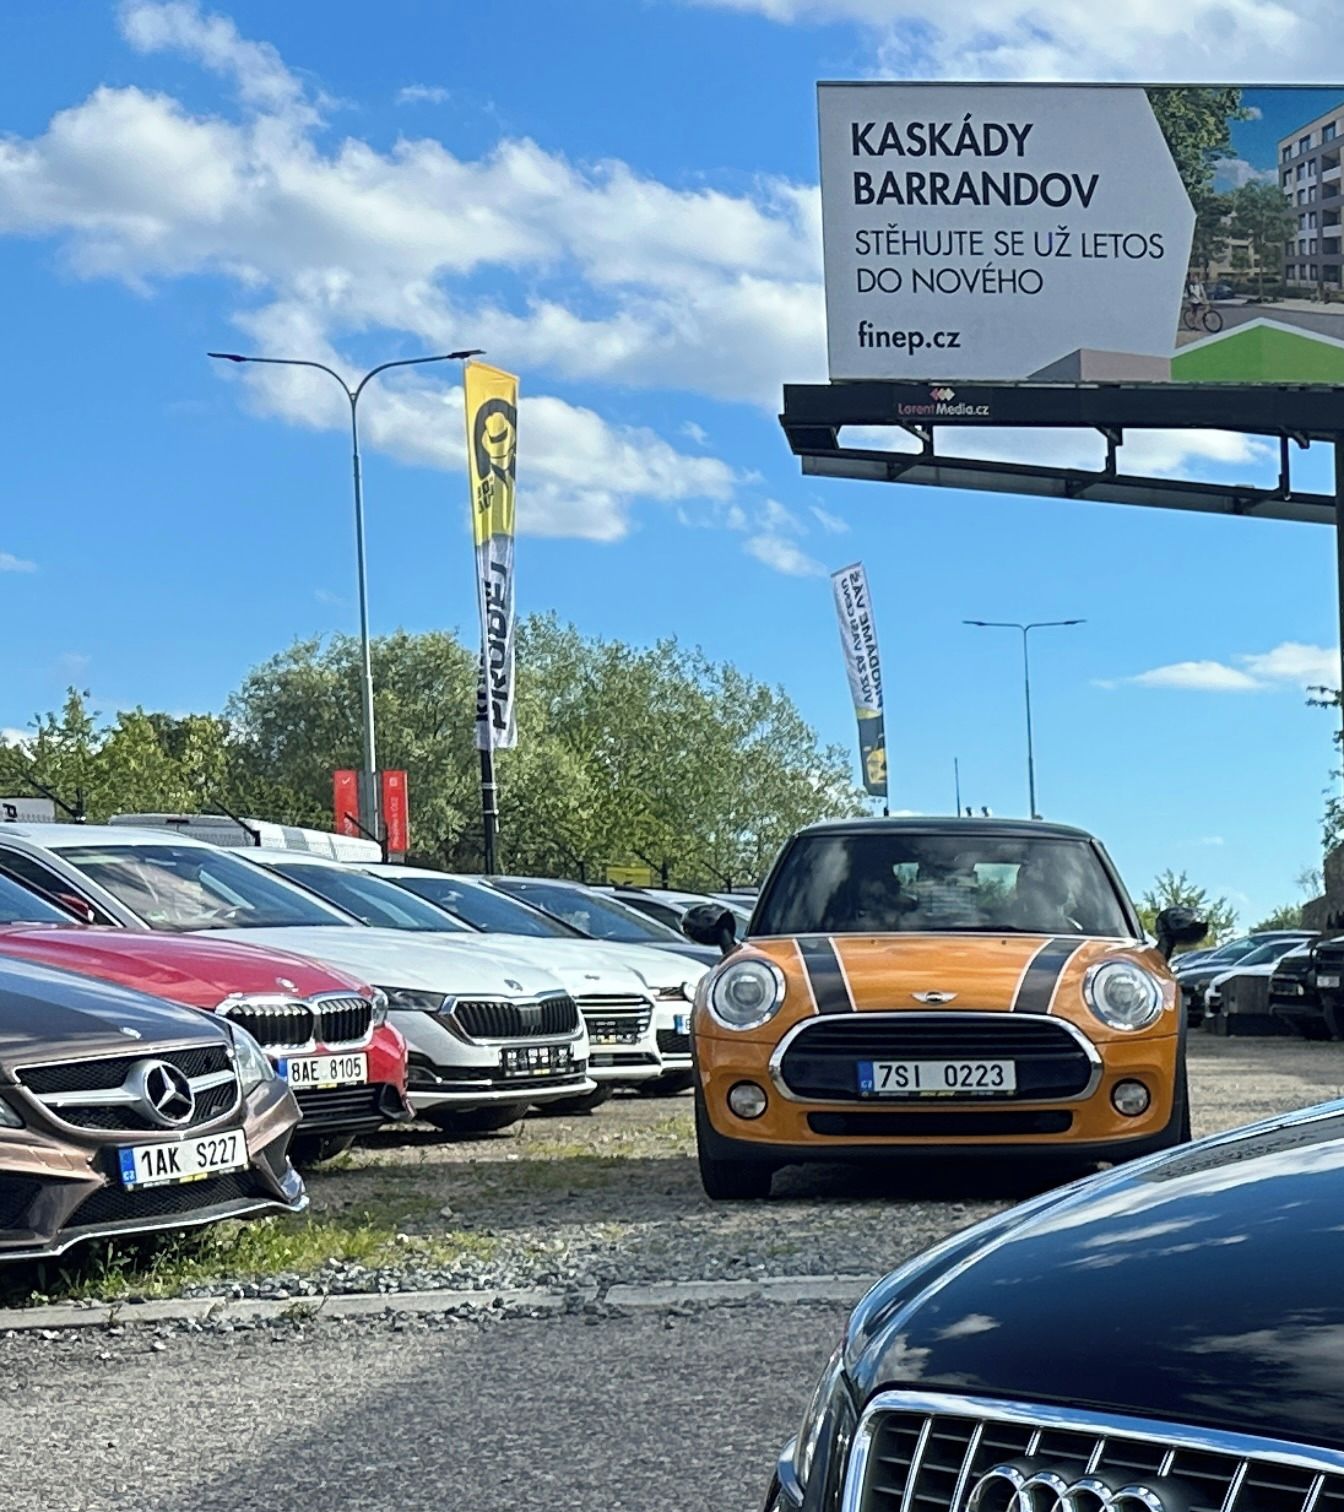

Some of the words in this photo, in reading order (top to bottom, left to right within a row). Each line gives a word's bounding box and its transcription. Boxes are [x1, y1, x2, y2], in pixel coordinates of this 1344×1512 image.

[851, 112, 1034, 157] KASKÁDY
[853, 171, 1099, 208] BARRANDOV
[855, 223, 984, 256] STĚHUJTE
[993, 231, 1025, 256] SE
[1034, 224, 1072, 258] UŽ
[1081, 232, 1165, 260] LETOS
[857, 268, 902, 293] DO
[912, 261, 1044, 295] NOVÉHO
[858, 319, 961, 355] finep.cz
[291, 1060, 320, 1082] 8AE
[330, 1057, 361, 1079] 8105
[879, 1064, 920, 1088] 7SI
[944, 1064, 1004, 1087] 0223
[141, 1147, 181, 1177] 1AK
[196, 1136, 237, 1168] S227
